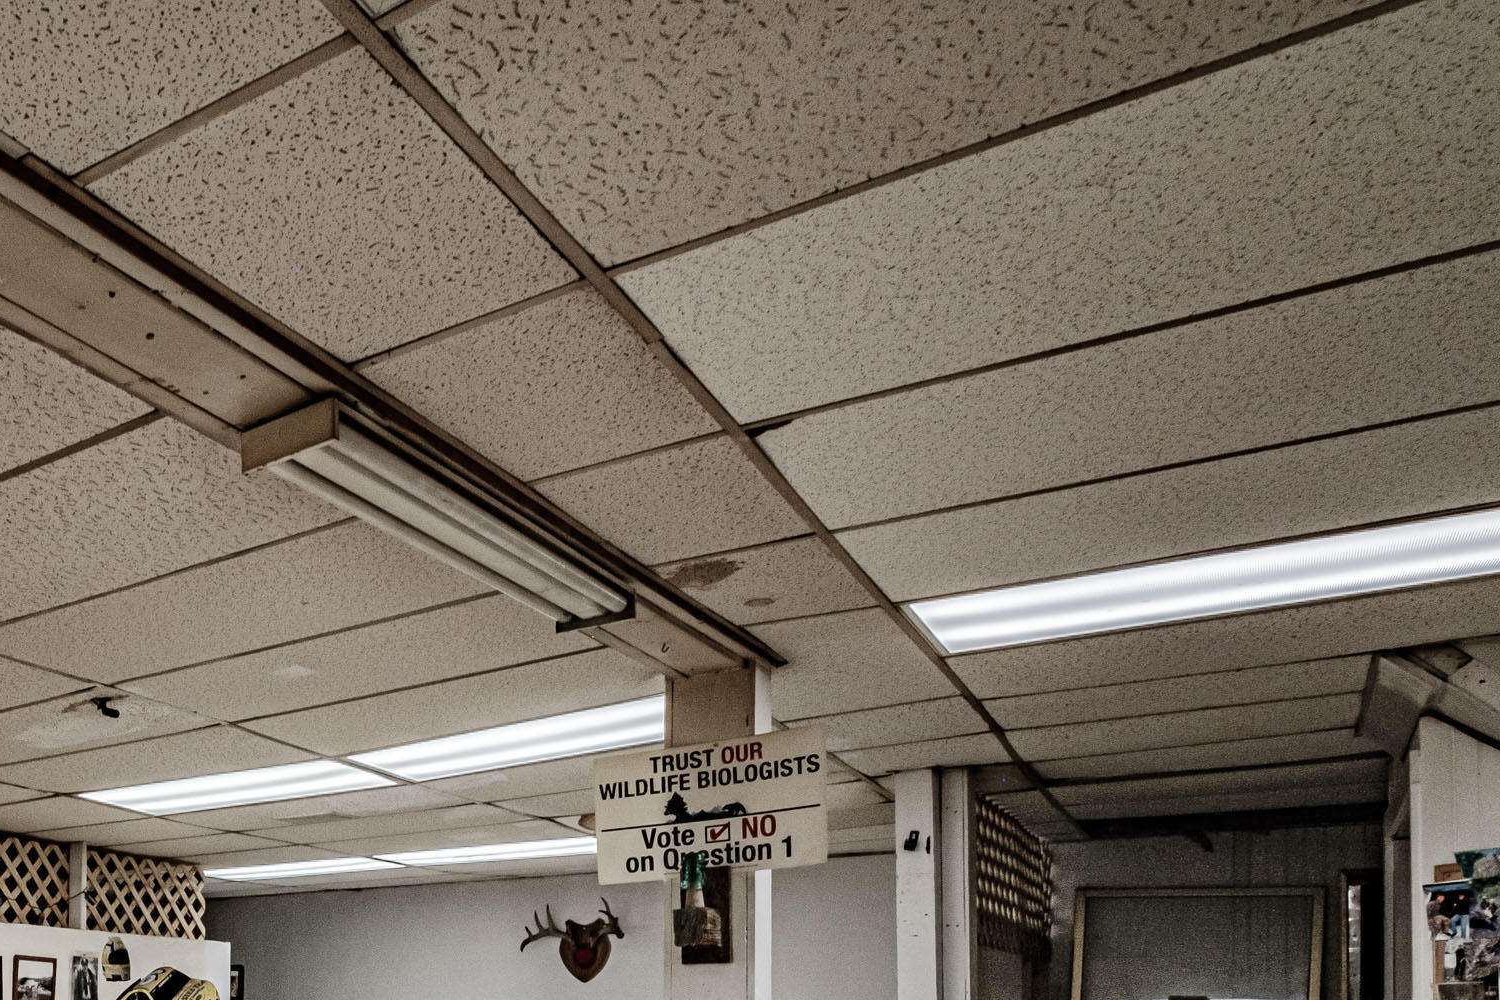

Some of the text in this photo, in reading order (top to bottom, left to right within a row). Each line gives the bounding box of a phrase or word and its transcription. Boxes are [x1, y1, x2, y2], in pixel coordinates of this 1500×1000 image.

[650, 741, 763, 774] TRUST OUR
[599, 753, 820, 800] WILDLIFE BIOLOGISTS
[641, 814, 776, 849] Vote NO
[626, 836, 792, 873] on Qestion 1
